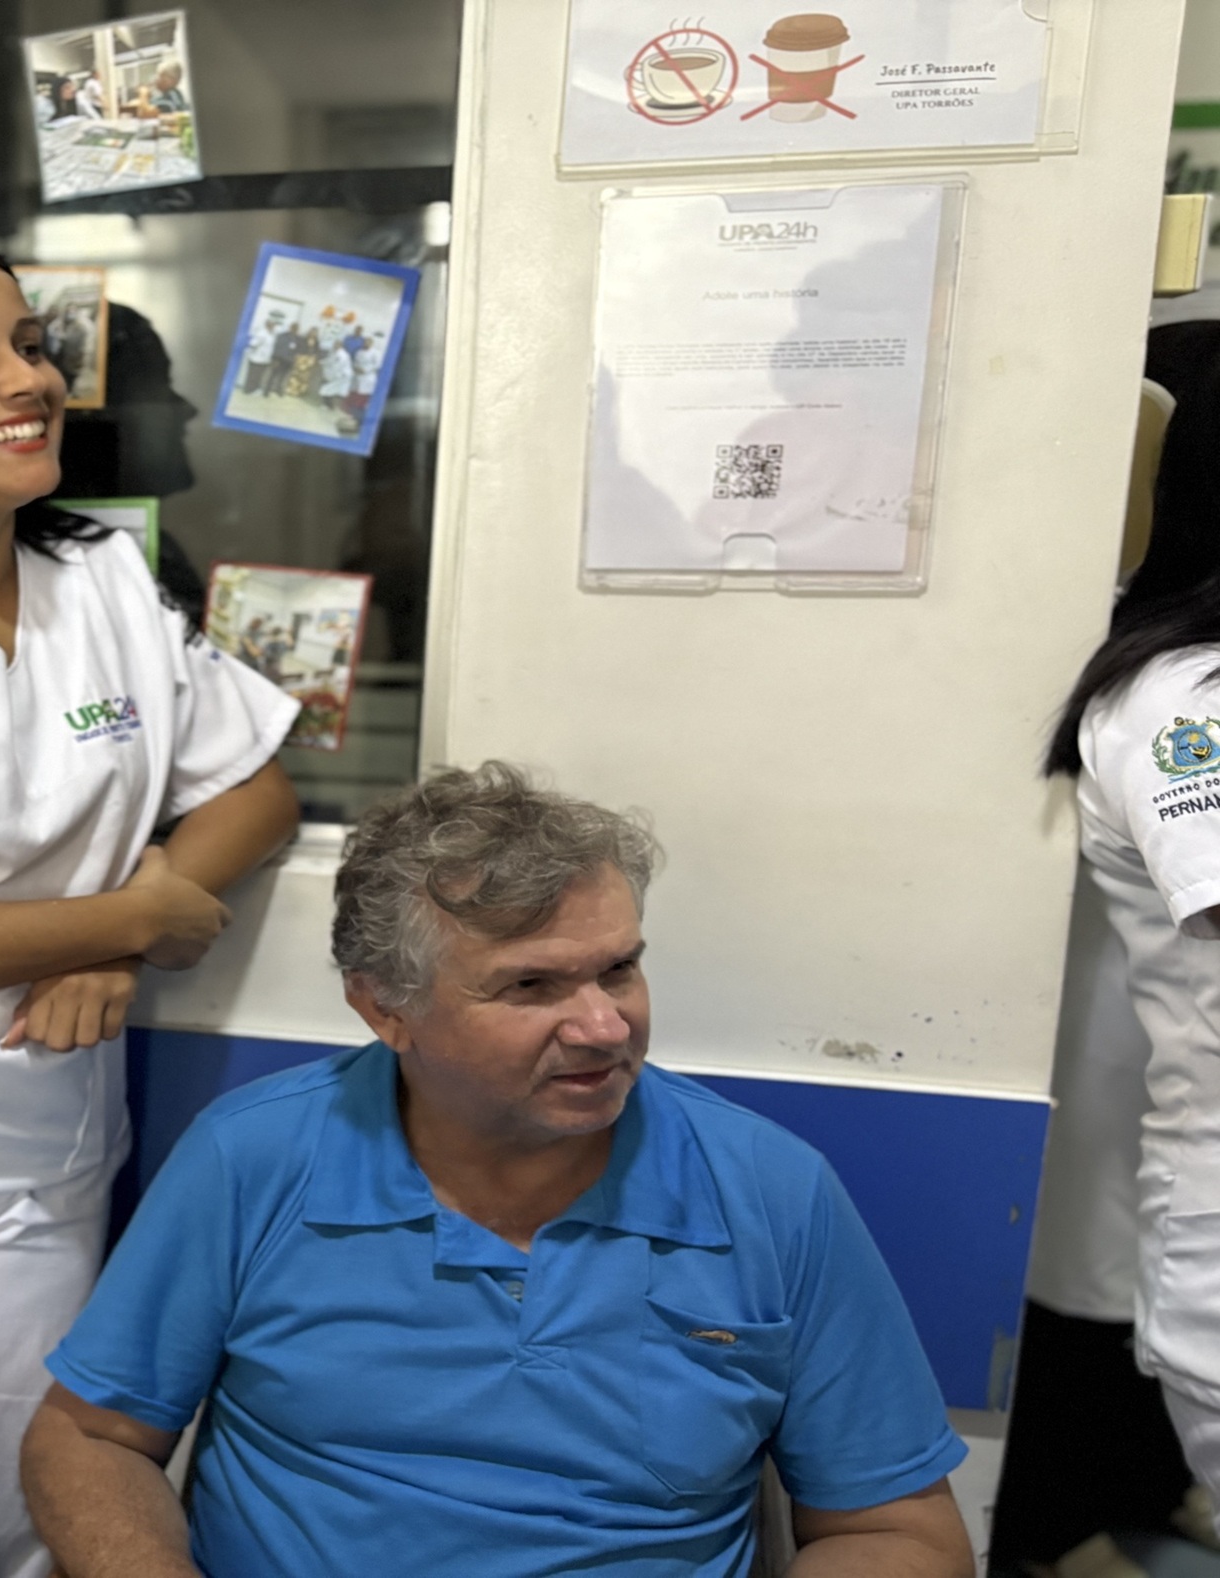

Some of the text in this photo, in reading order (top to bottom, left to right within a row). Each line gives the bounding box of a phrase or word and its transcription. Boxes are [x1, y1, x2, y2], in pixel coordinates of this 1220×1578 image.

[880, 61, 996, 76] José F. Passavante
[891, 87, 980, 98] DIRETOR GERAL
[896, 98, 974, 110] UPA TORRÕES
[718, 221, 818, 241] UPA24h
[742, 290, 770, 299] uma
[773, 288, 819, 298] história
[1152, 783, 1200, 804] GOVERNO
